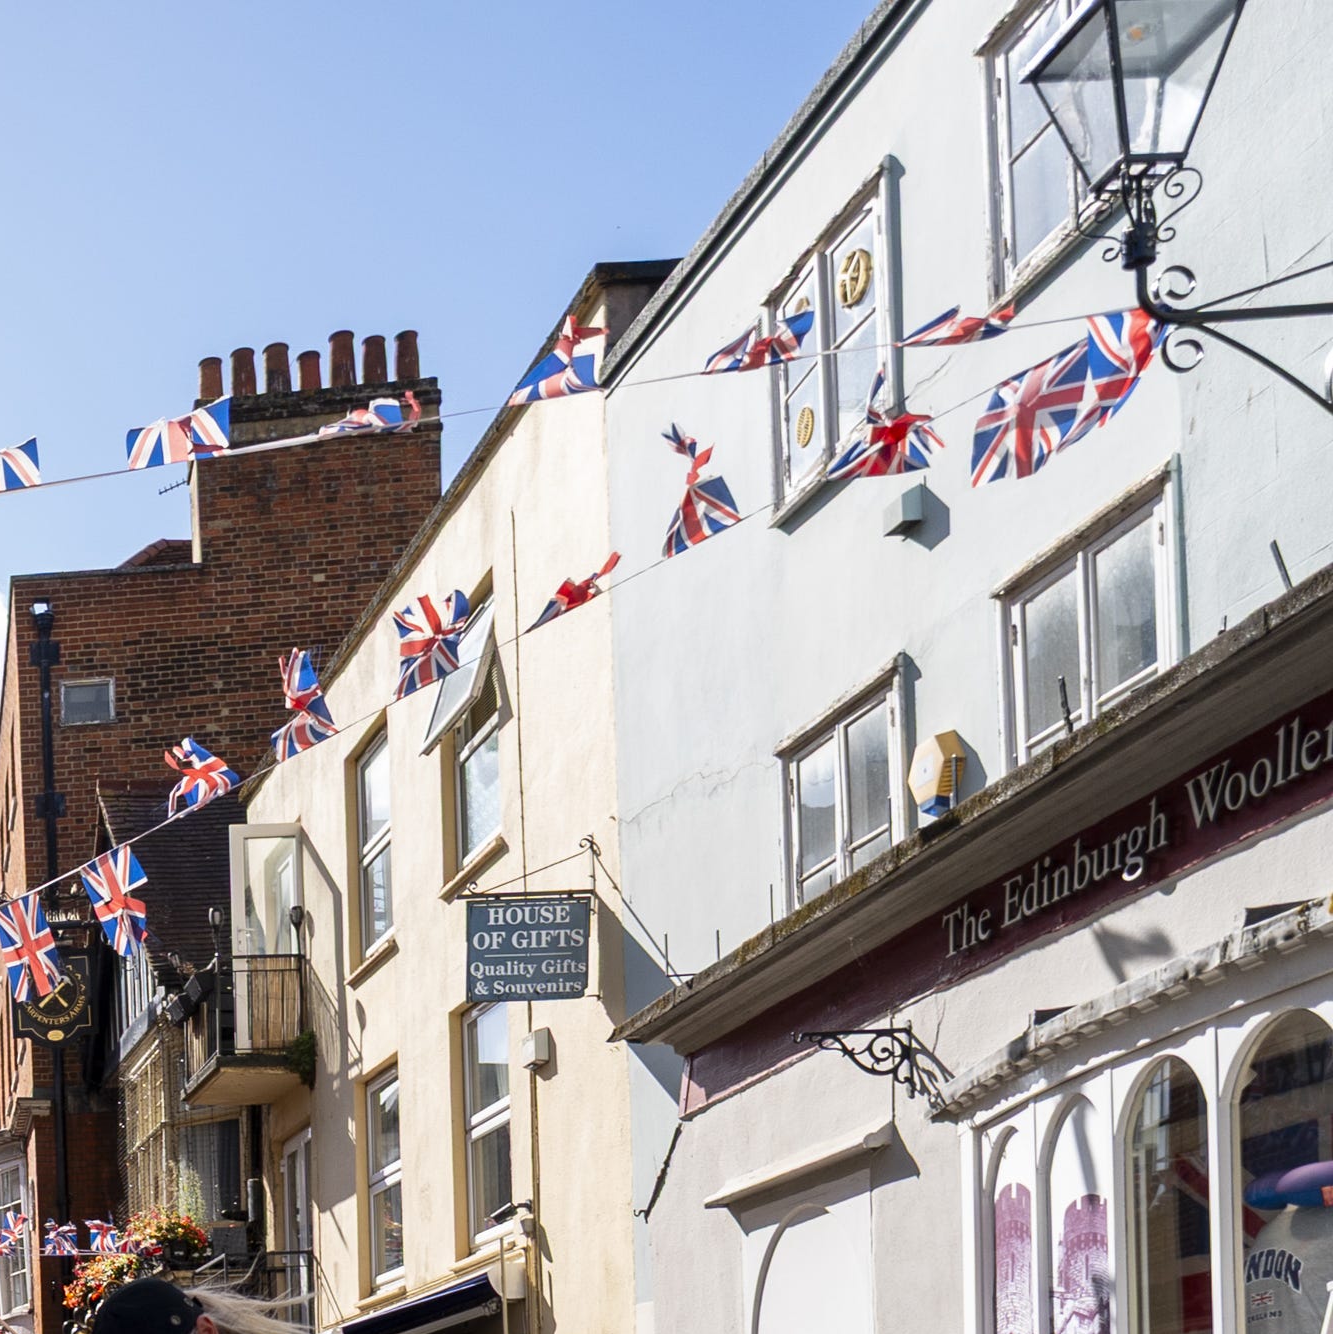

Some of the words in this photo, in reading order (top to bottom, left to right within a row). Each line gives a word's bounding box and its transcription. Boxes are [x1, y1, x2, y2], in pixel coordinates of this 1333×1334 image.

[942, 901, 992, 958] The
[1000, 797, 1168, 928] Edinburgh
[487, 905, 570, 926] HOUSE
[473, 931, 506, 950] OF
[511, 928, 584, 949] GIFTS
[470, 960, 537, 979] Quality
[541, 959, 587, 974] Gifts
[474, 980, 489, 995] &
[493, 978, 582, 995] Souvenirs
[27, 1004, 70, 1025] ARPENTERS
[1244, 1247, 1304, 1295] NDON
